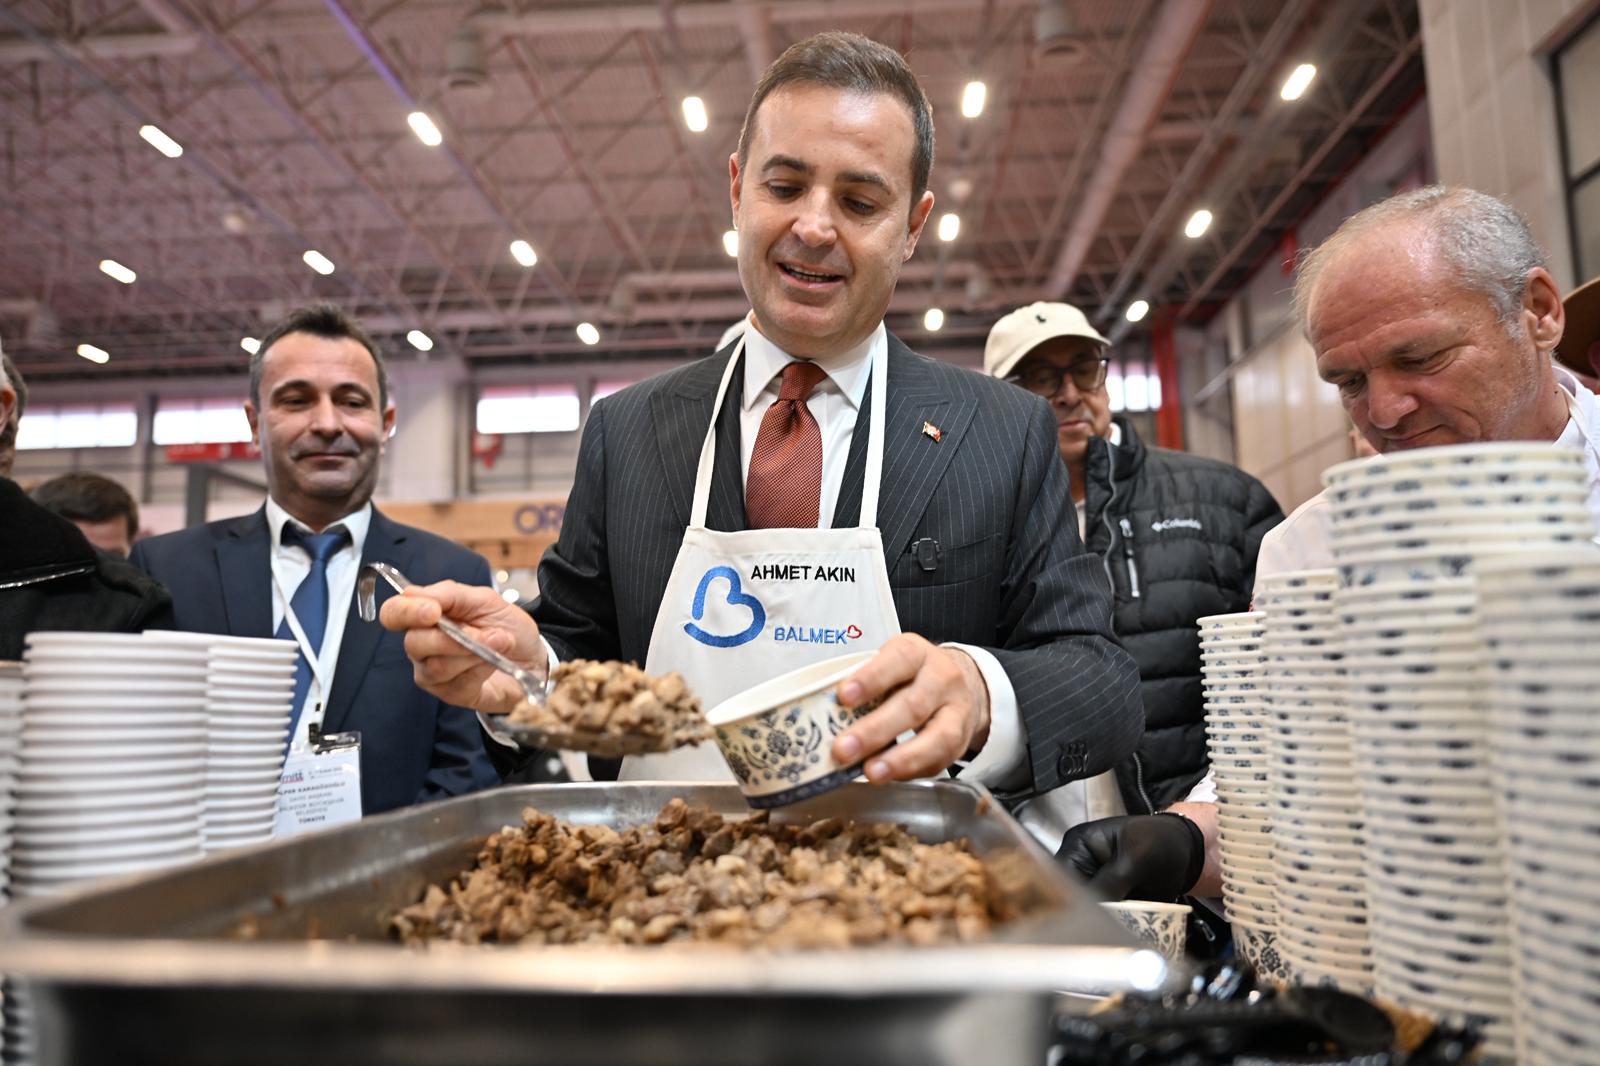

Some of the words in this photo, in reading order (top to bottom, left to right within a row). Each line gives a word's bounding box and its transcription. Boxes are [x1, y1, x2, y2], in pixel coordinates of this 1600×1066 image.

[751, 565, 812, 580] AHMET
[814, 566, 856, 582] AKIN
[774, 627, 847, 644] BALMEK
